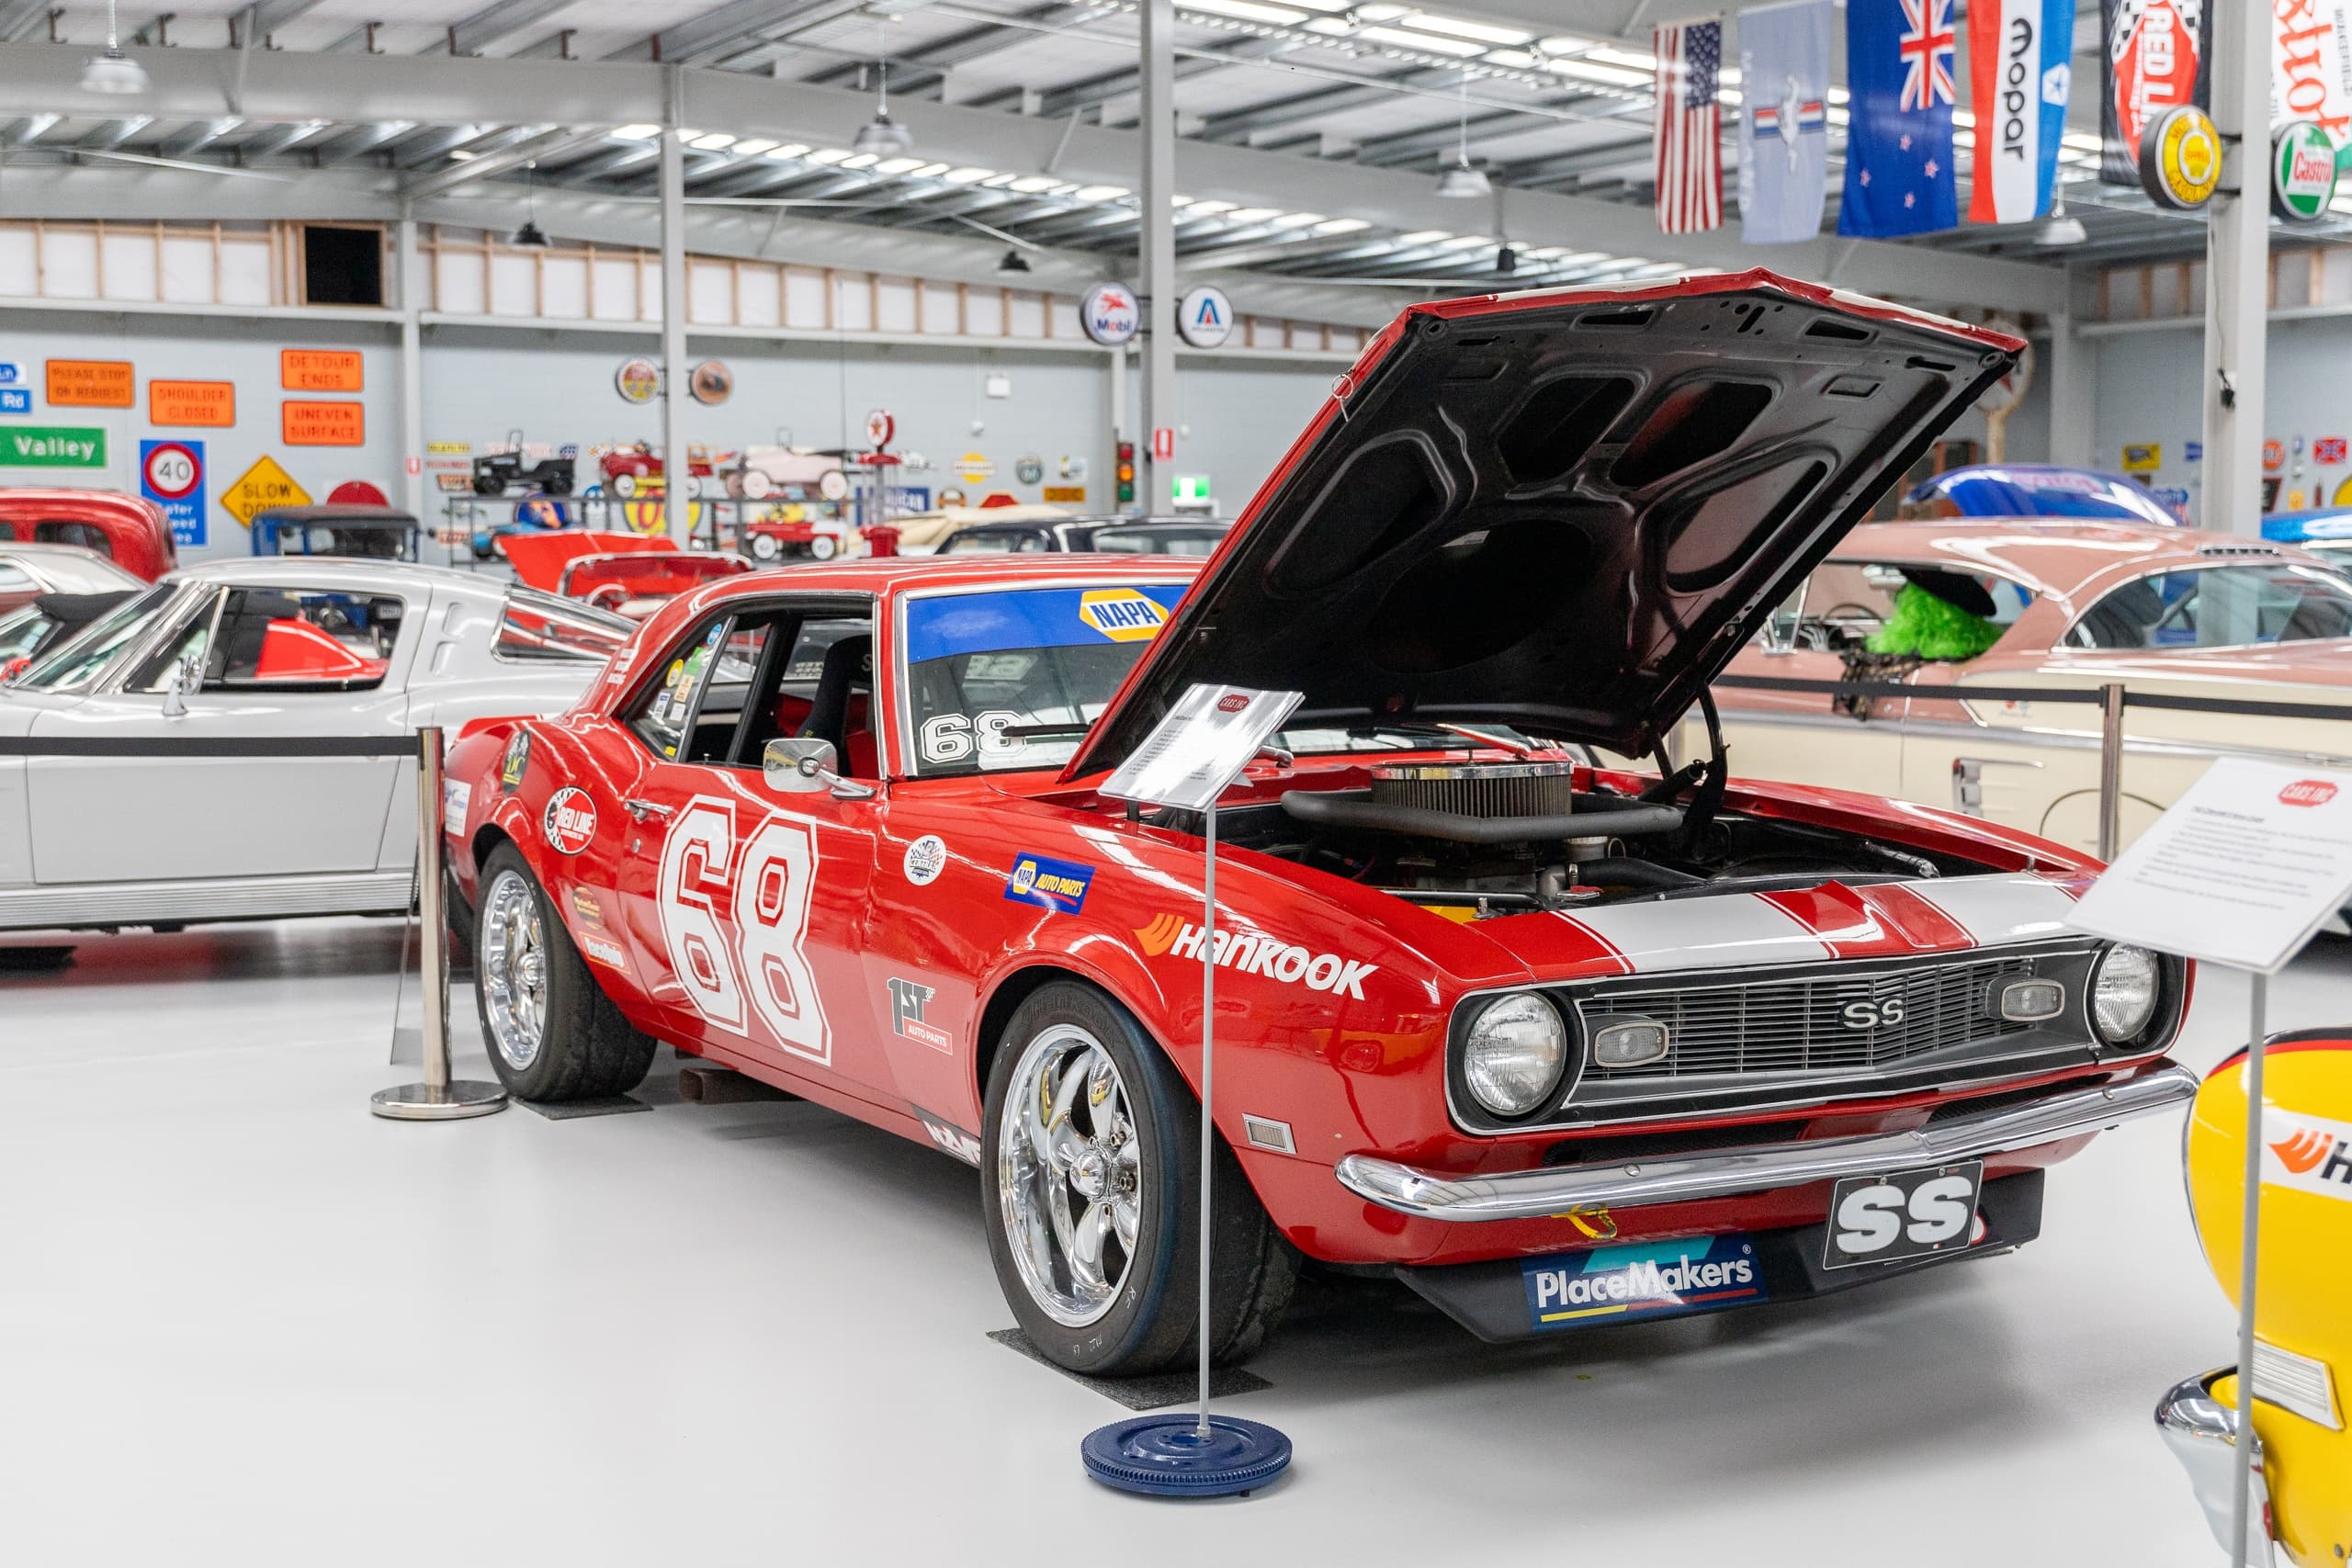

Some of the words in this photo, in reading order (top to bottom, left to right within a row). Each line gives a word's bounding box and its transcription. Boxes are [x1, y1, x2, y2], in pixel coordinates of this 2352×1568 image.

[2143, 7, 2175, 76] RED
[2293, 151, 2333, 185] Castrol
[1096, 319, 1132, 332] Mobil
[289, 355, 355, 368] DETOUR
[300, 373, 345, 387] ENDS
[3, 392, 24, 408] Rd
[159, 389, 226, 402] SHOULDER
[168, 406, 218, 420] CLOSED
[294, 408, 353, 421] UNEVEN
[290, 426, 356, 440] SURFACE
[15, 435, 96, 461] Valley
[159, 460, 191, 481] 40
[243, 484, 292, 498] SLOW
[165, 504, 193, 515] afer
[1090, 601, 1161, 628] NAPA
[920, 710, 1027, 764] 68
[558, 807, 575, 829] RED
[1016, 868, 1034, 885] NAPA
[1035, 874, 1057, 892] AUTO
[1057, 878, 1086, 897] PARTS
[656, 794, 831, 1066] 68
[1843, 998, 1904, 1029] SS
[908, 1023, 926, 1040] AUTO
[926, 1029, 947, 1047] PARTS
[1837, 1175, 1973, 1254] SS
[1536, 1254, 1754, 1308] PlaceMakers
